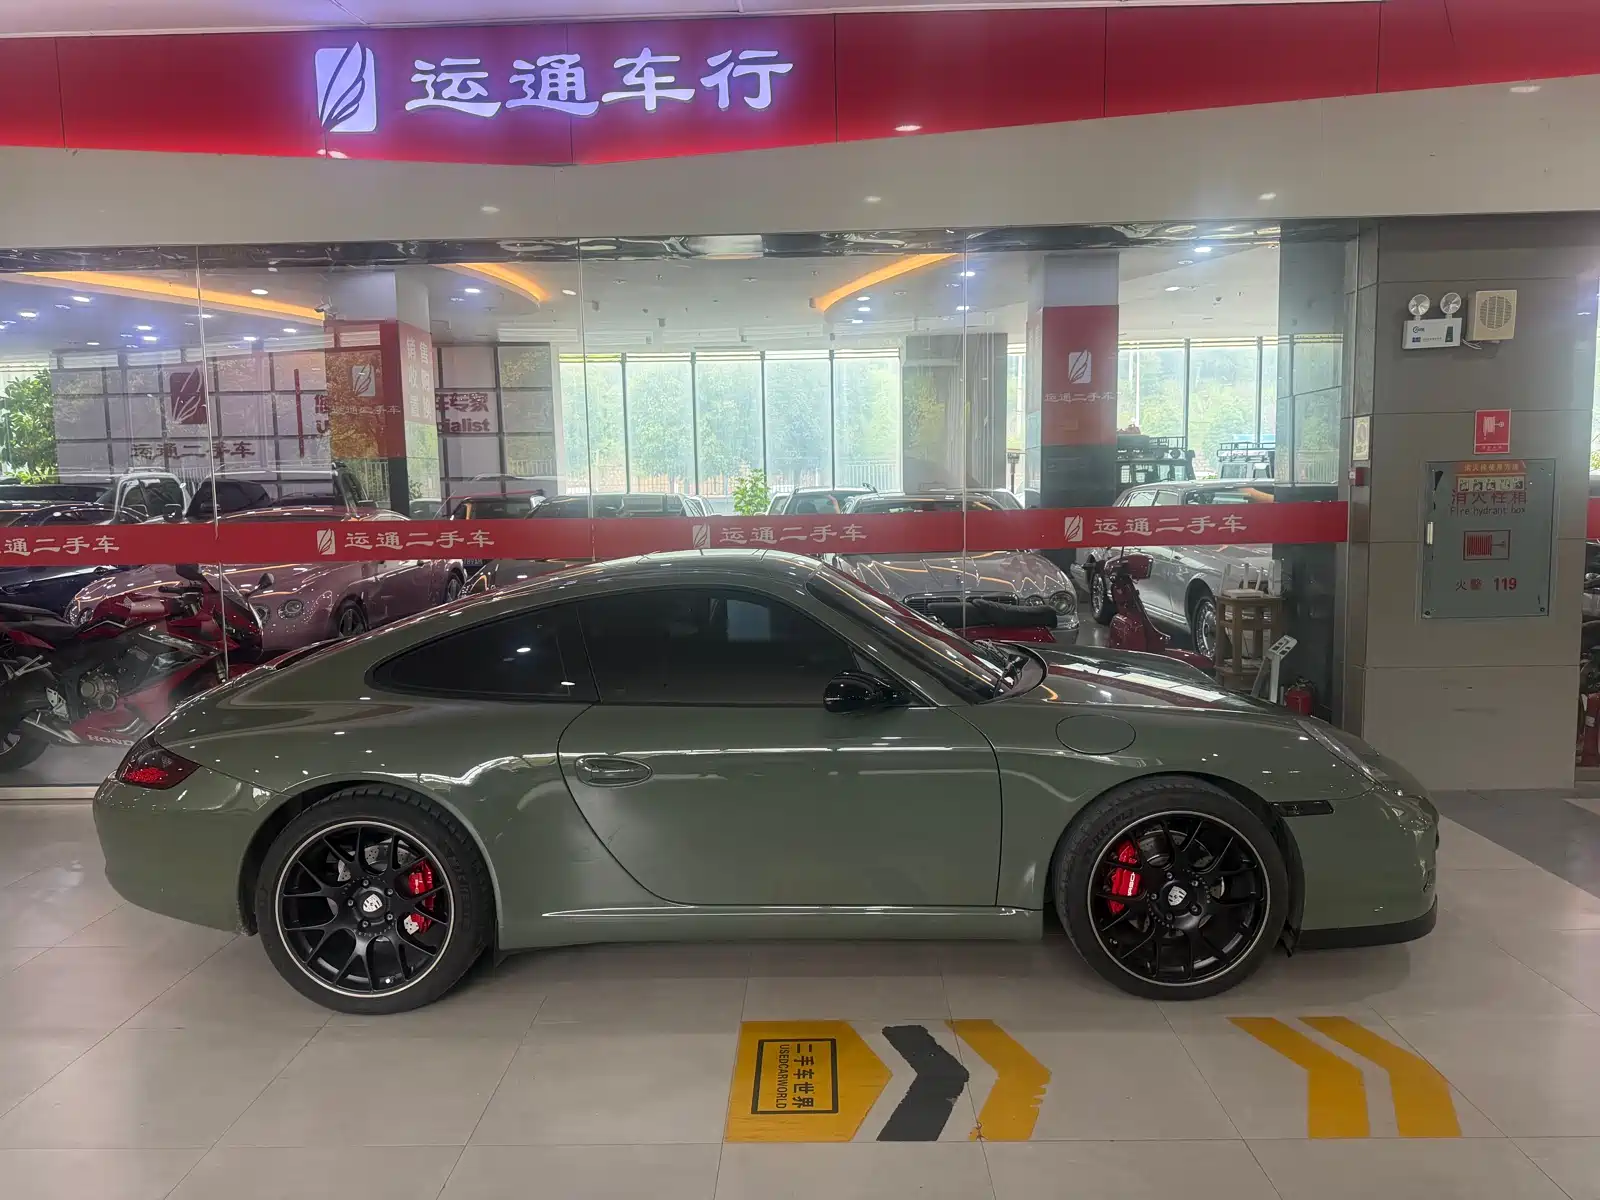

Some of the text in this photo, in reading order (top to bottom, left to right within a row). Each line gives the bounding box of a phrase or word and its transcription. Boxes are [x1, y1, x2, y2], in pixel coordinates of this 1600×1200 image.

[404, 46, 794, 118] 运通车行
[1473, 505, 1507, 516] hydrant
[1511, 503, 1526, 514] box
[719, 524, 867, 545] 运通二手车
[1091, 514, 1247, 536] 运通二手车
[0, 534, 120, 557] 通二手车
[344, 529, 495, 550] 运通二手车
[1493, 576, 1517, 592] 119
[87, 734, 136, 746] HOND
[775, 1043, 790, 1109] USEDCARWORLD
[792, 1043, 815, 1109] 二手车世界
